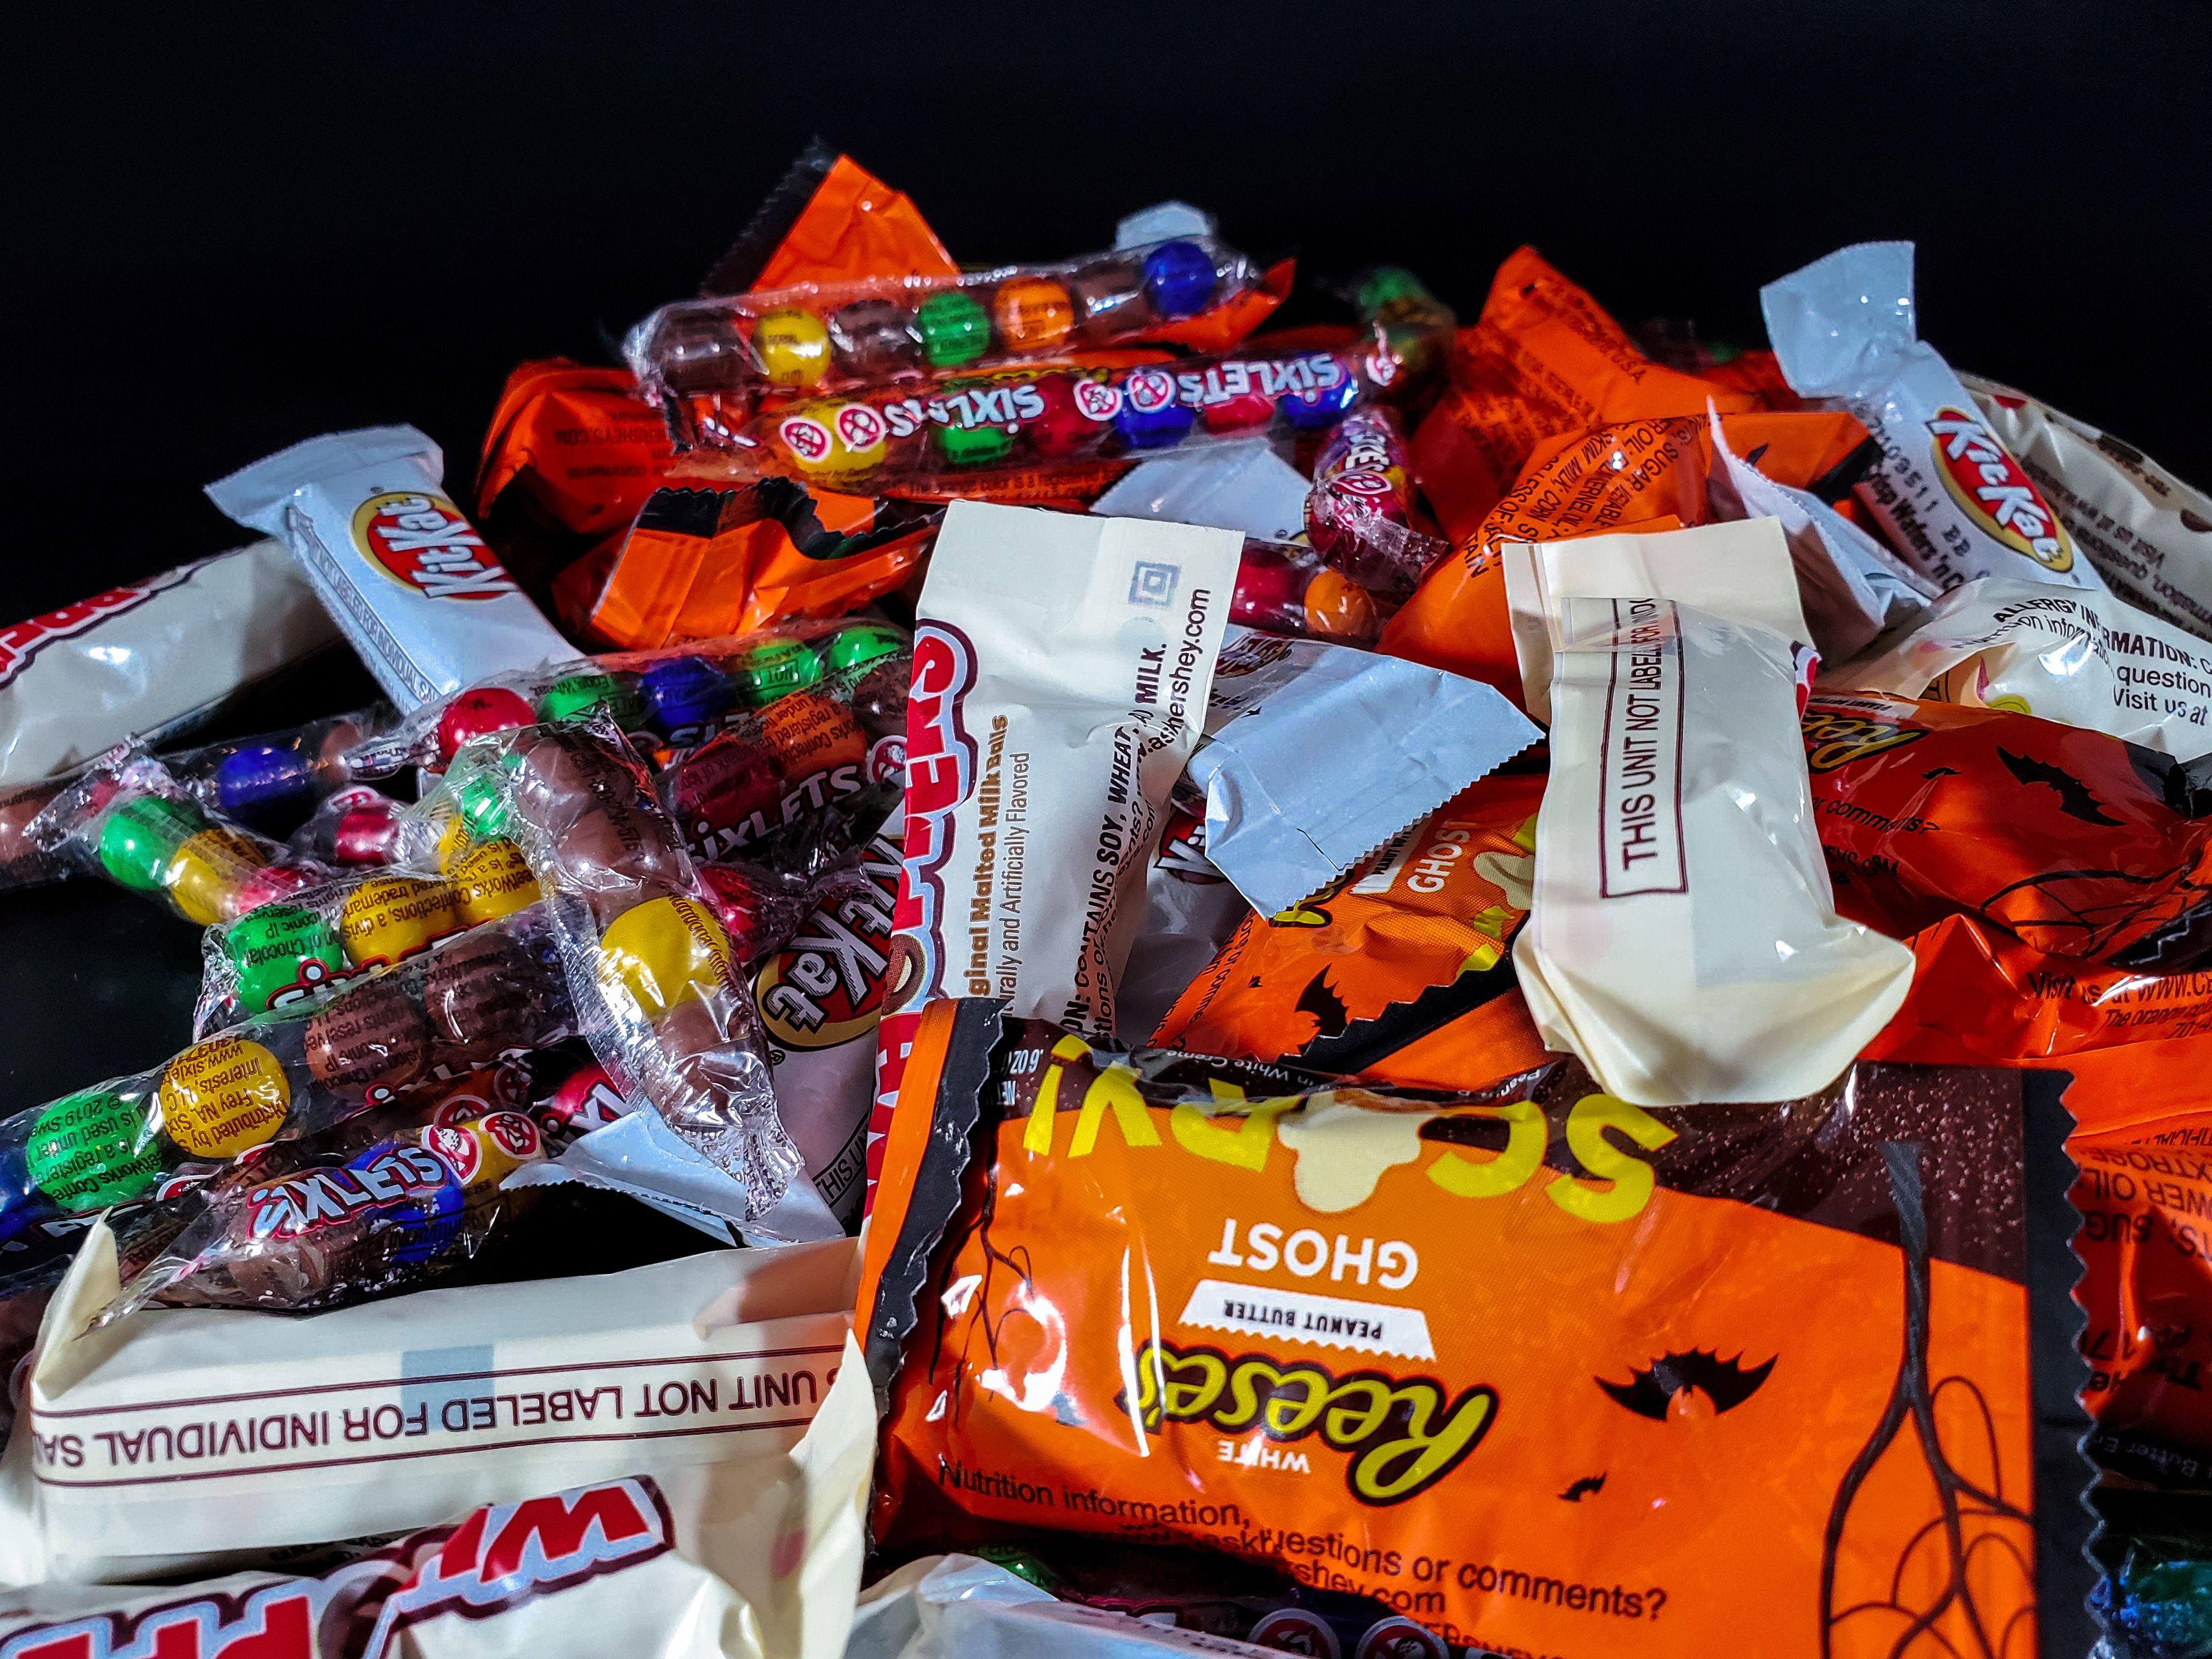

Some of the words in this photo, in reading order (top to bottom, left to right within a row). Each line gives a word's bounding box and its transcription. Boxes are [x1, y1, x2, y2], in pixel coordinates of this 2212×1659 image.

[1993, 598, 2076, 623] ALLERGY
[1624, 693, 1660, 733] NOT
[2112, 685, 2158, 712] Visit
[2165, 700, 2188, 717] us
[2190, 704, 2209, 726] at
[988, 714, 1010, 768] Balls
[1097, 814, 1127, 868] SOY,
[1135, 643, 1167, 704] MILK.
[1622, 737, 1657, 791] UNIT
[978, 768, 1002, 828] Milk
[1012, 752, 1031, 823] Flavored
[1622, 793, 1658, 872] THIS
[970, 833, 1000, 924] Malted
[1002, 823, 1030, 913] Artificially
[1002, 915, 1021, 952] and
[194, 1057, 263, 1094] Interests,
[1234, 1059, 1290, 1082] White
[63, 1097, 103, 1127] 2019
[219, 1087, 254, 1112] Frey
[81, 1116, 120, 1144] used
[190, 1128, 212, 1149] by
[210, 1097, 290, 1146] Distributed
[104, 1143, 116, 1160] a
[1209, 1217, 1418, 1290] GHOST
[1224, 1298, 1296, 1325] BUTTER
[1303, 1312, 1384, 1340] PEANUT
[441, 1386, 623, 1432] LABELED
[633, 1378, 718, 1417] NOT
[728, 1369, 819, 1410] UNIT
[94, 1411, 331, 1466] INDIVIDUAL
[343, 1401, 430, 1443] FOR
[938, 1459, 1055, 1508] Nutrition
[1063, 1484, 1250, 1529] information,
[1412, 1554, 1448, 1583] or
[1457, 1560, 1668, 1622] comments?
